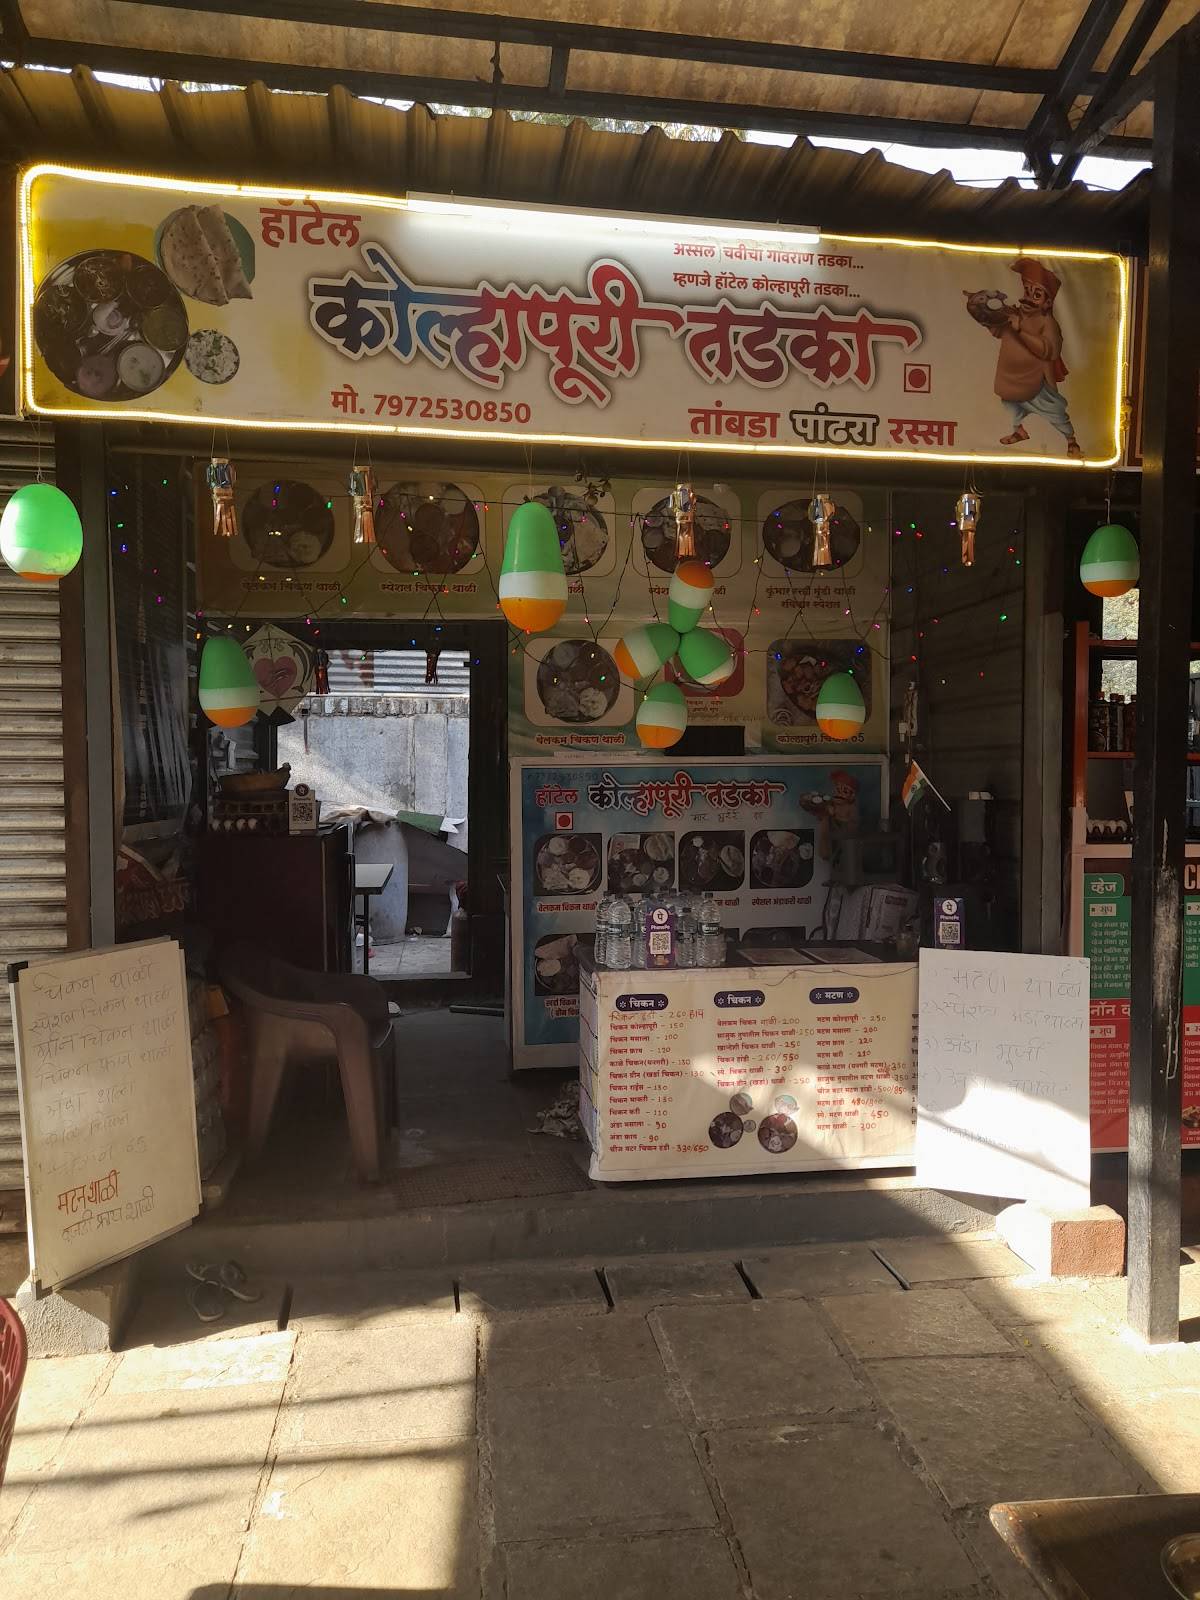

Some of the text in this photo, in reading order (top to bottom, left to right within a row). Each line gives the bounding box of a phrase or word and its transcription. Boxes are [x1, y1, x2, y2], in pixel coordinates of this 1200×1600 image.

[260, 200, 361, 248] हॉटेल
[673, 242, 715, 258] अस्सल
[766, 248, 814, 266] गावराण
[673, 270, 711, 289] म्हणजे
[714, 271, 749, 290] हॉटेल
[752, 273, 810, 299] कोल्हापूरी
[309, 242, 922, 408] कोल्हापूरी तडका
[331, 384, 531, 424] मो. 7972530850
[687, 400, 958, 447] तांबडा पांढरा रस्सा
[452, 582, 477, 593] थाळी
[602, 733, 625, 745] थाळी
[535, 784, 579, 808] हॉटेल
[588, 772, 785, 819] कोल्हापूरी तडका
[1090, 878, 1117, 894] व्हेज
[629, 997, 655, 1009] चिकन
[727, 994, 752, 1005] चिकन
[824, 990, 845, 1001] मटण
[1091, 1001, 1116, 1017] नॉन
